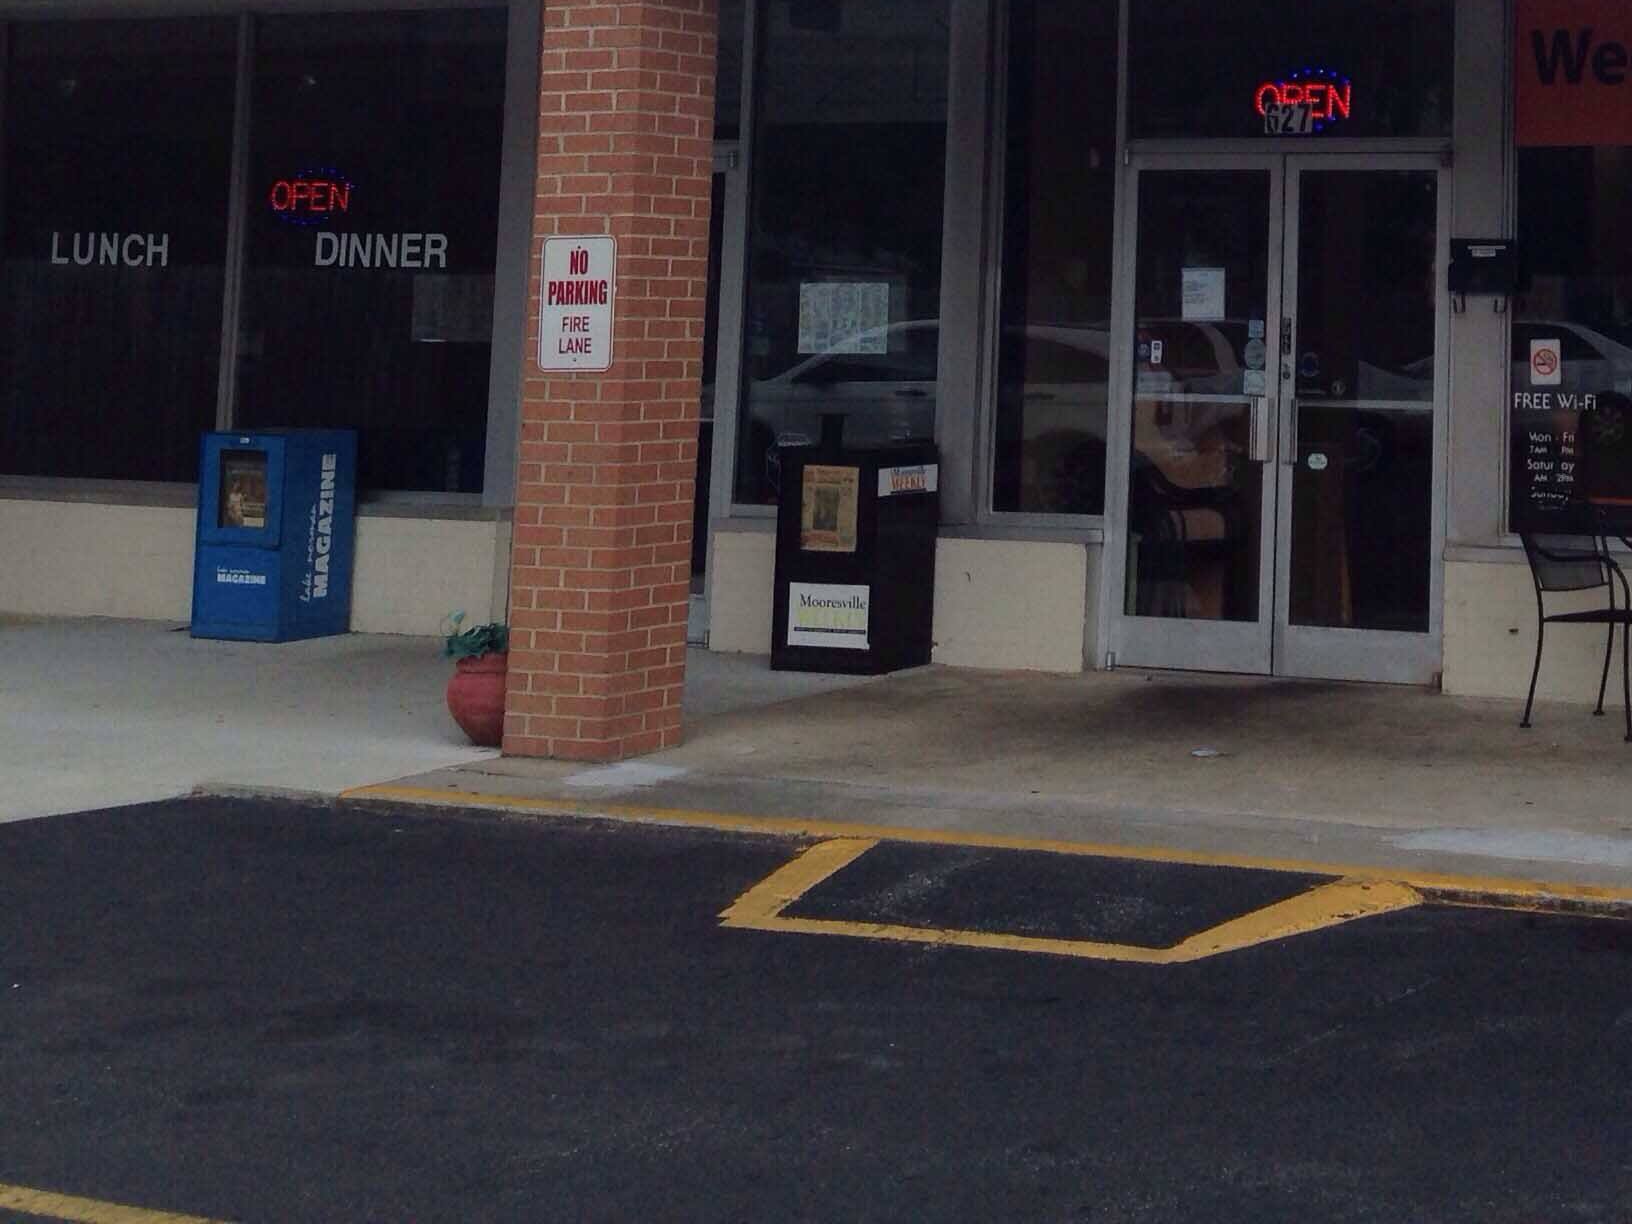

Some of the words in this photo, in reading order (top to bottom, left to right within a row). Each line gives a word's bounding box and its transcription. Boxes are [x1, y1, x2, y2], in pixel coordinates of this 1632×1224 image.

[1255, 81, 1351, 119] OPEN
[1266, 102, 1311, 133] 627
[269, 180, 351, 213] OPEN
[50, 231, 169, 268] LUNCH
[314, 231, 448, 269] DINNER
[569, 249, 589, 275] NO
[547, 279, 608, 306] PARKING
[562, 316, 590, 332] FIRE
[558, 337, 592, 354] LANE
[1514, 392, 1551, 409] FREE
[1527, 458, 1575, 474] Saturay
[312, 453, 337, 598] MAGAZINE
[799, 592, 867, 610] Mooresville
